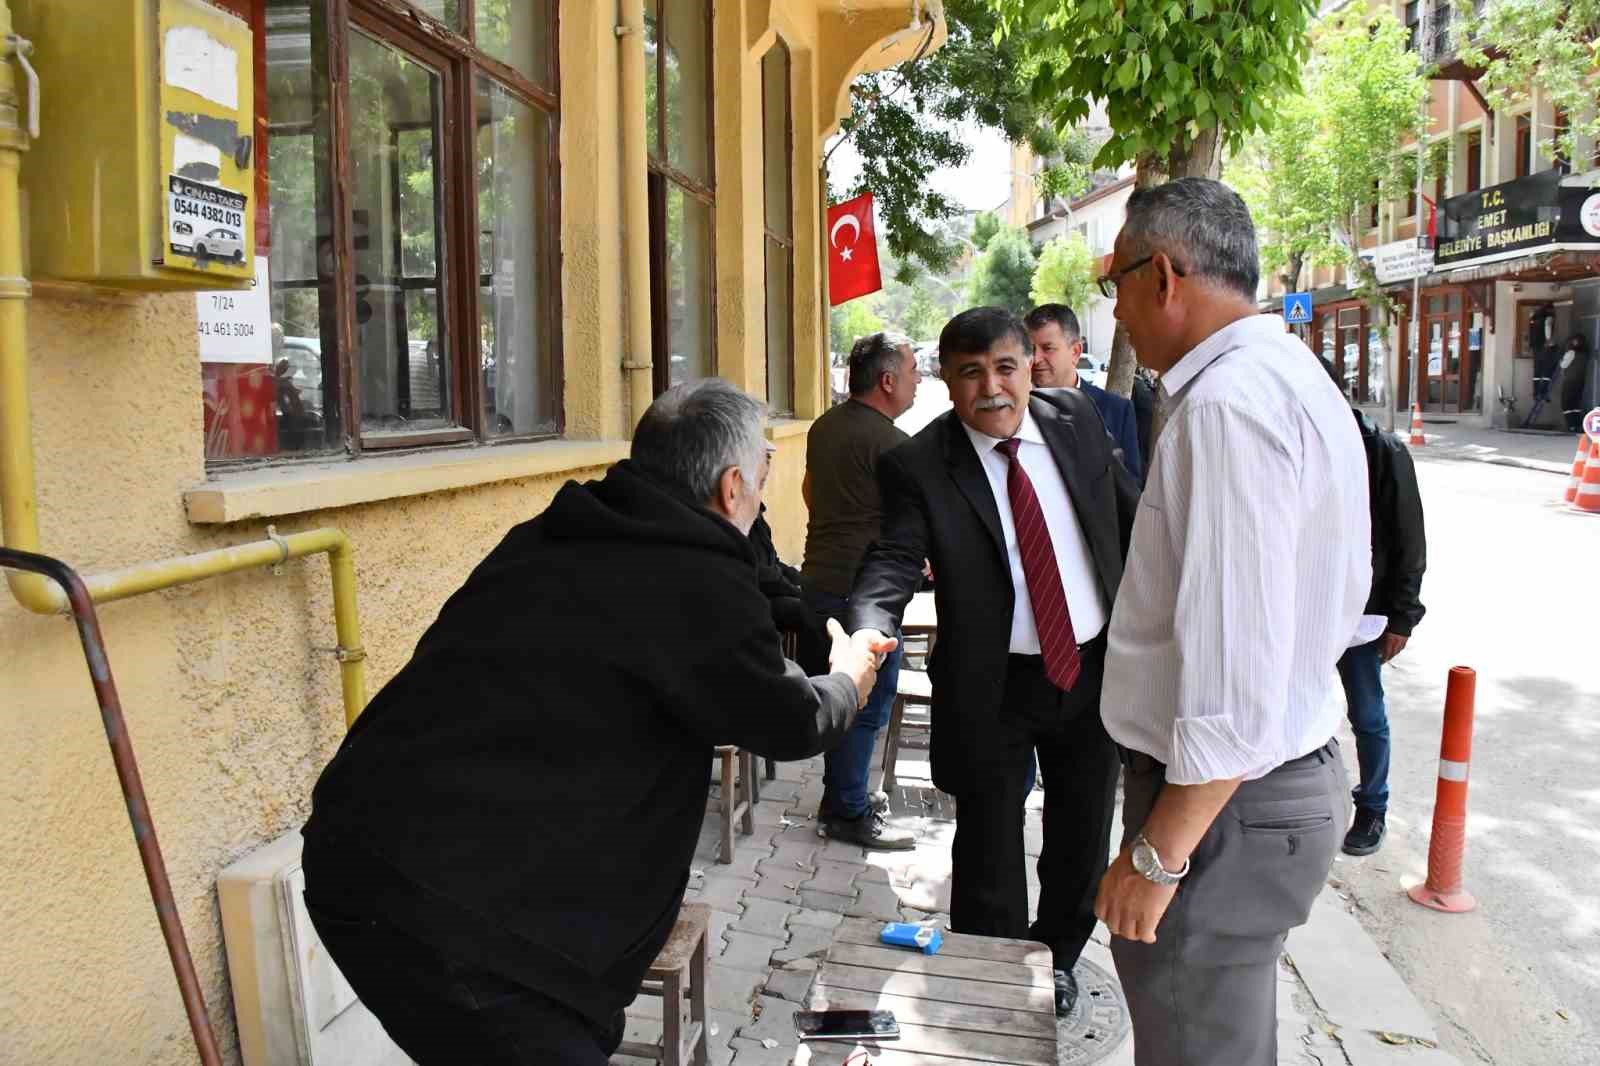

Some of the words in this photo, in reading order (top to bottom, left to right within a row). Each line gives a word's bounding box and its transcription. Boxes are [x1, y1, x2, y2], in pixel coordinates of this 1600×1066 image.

[1482, 190, 1505, 208] T.C.
[174, 198, 199, 216] 0544
[201, 205, 224, 223] 4382
[225, 211, 241, 227] 013
[1477, 209, 1507, 229] EMET
[212, 296, 234, 312] 7/24
